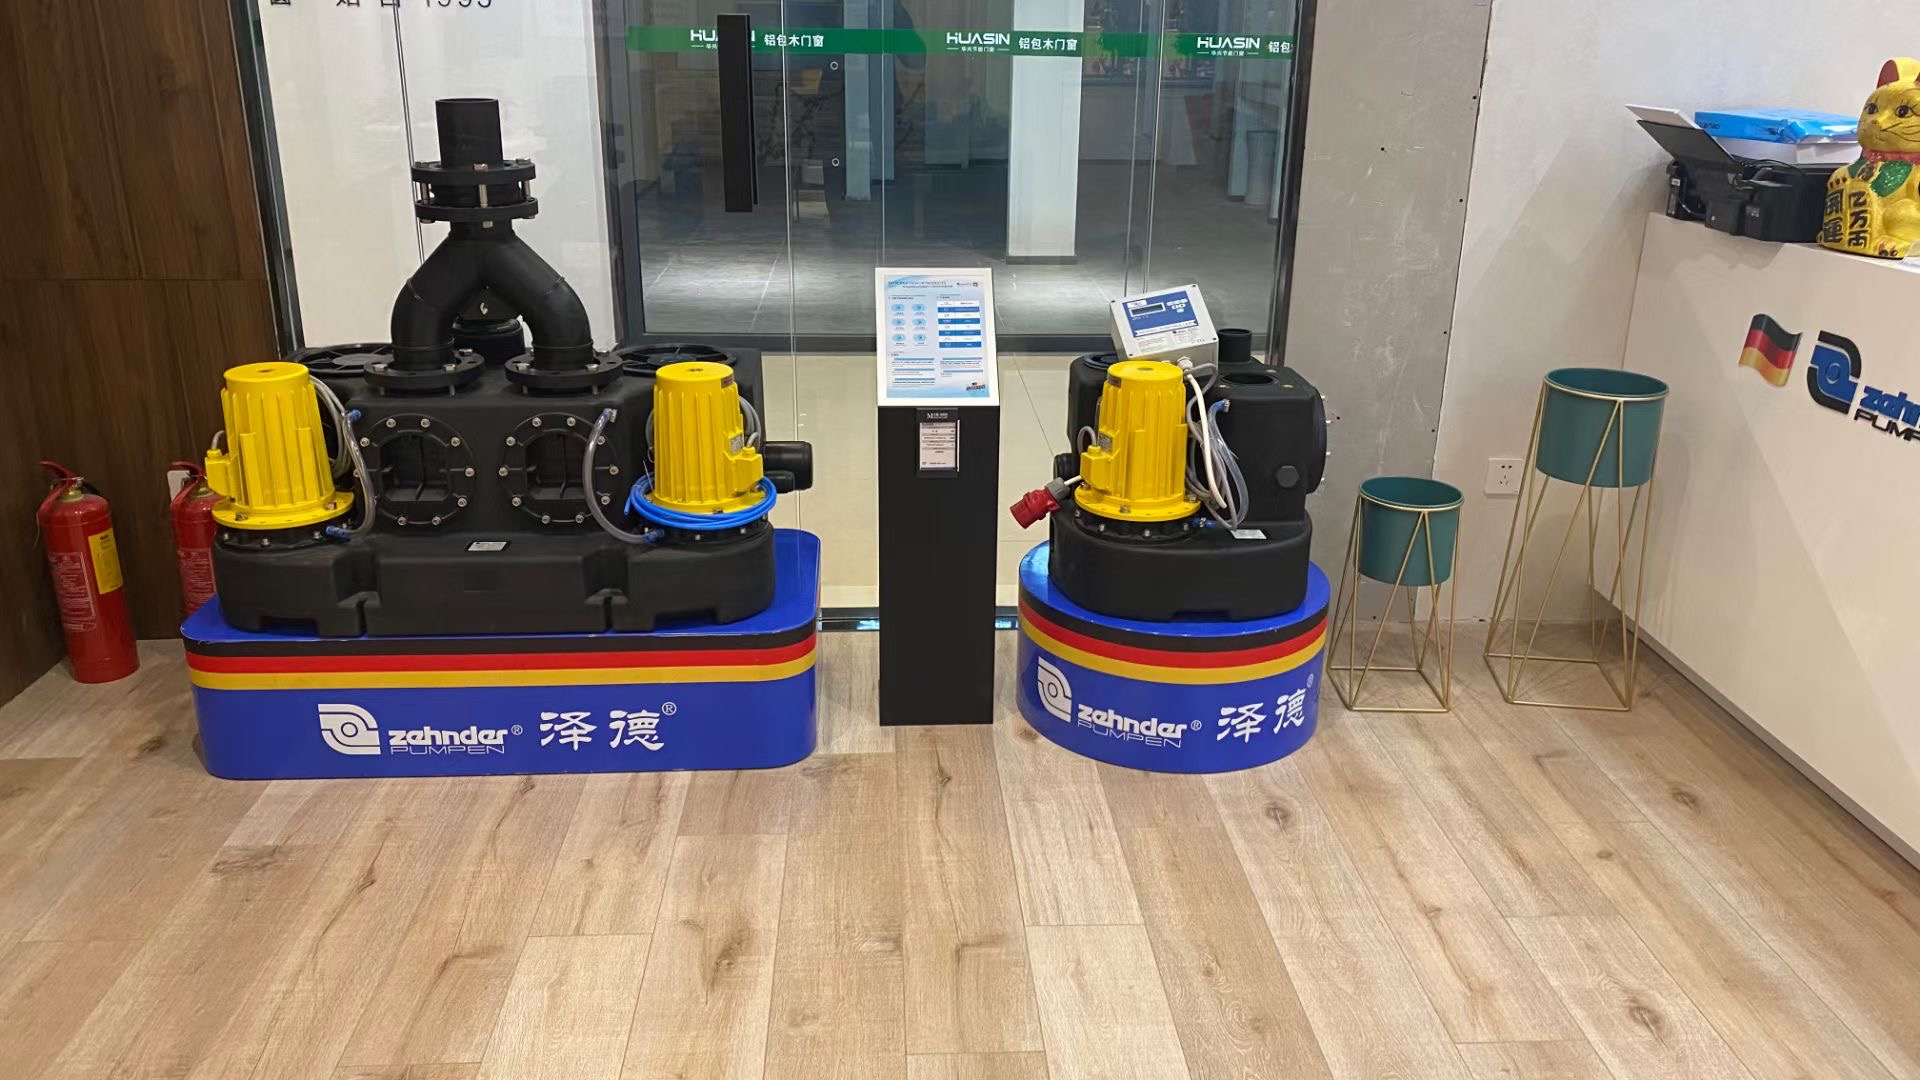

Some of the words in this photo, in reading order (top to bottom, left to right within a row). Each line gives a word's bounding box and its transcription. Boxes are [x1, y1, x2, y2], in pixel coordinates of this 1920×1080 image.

[764, 34, 824, 48] 铝包木门窗
[946, 32, 1010, 45] HUASIN
[1018, 37, 1078, 51] 铝包木门窗
[1197, 36, 1260, 49] HUASIN
[1268, 41, 1293, 54] 铝包
[1078, 703, 1188, 739] zehnder
[388, 725, 508, 746] zehnder
[1077, 720, 1182, 749] PUMPEN
[389, 745, 506, 755] PUMPEN
